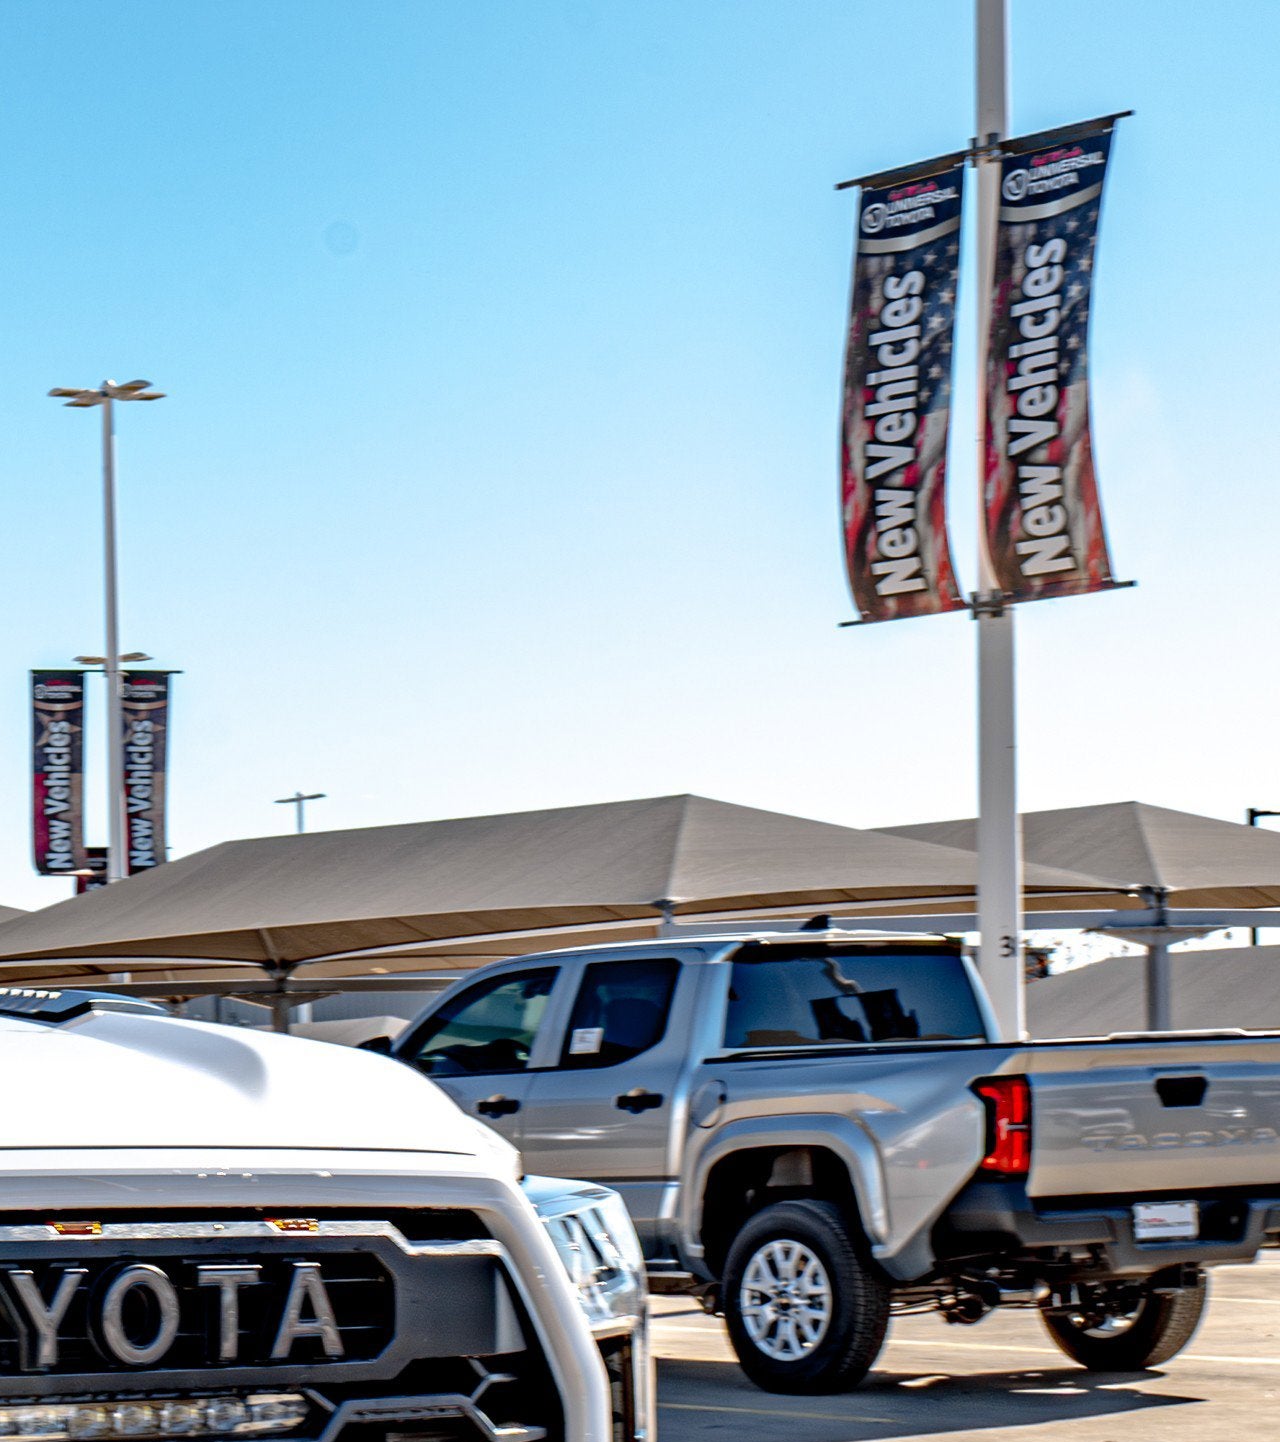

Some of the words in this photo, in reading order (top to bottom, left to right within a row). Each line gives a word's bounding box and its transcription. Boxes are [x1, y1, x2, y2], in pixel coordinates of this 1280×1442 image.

[864, 270, 926, 481] Vehicles
[1008, 237, 1067, 458] Vehicles
[871, 487, 928, 597] New
[1016, 465, 1077, 578] New
[44, 721, 71, 815] Vehicles
[127, 720, 153, 814] Vehicles
[46, 819, 74, 868] New
[130, 817, 157, 867] New
